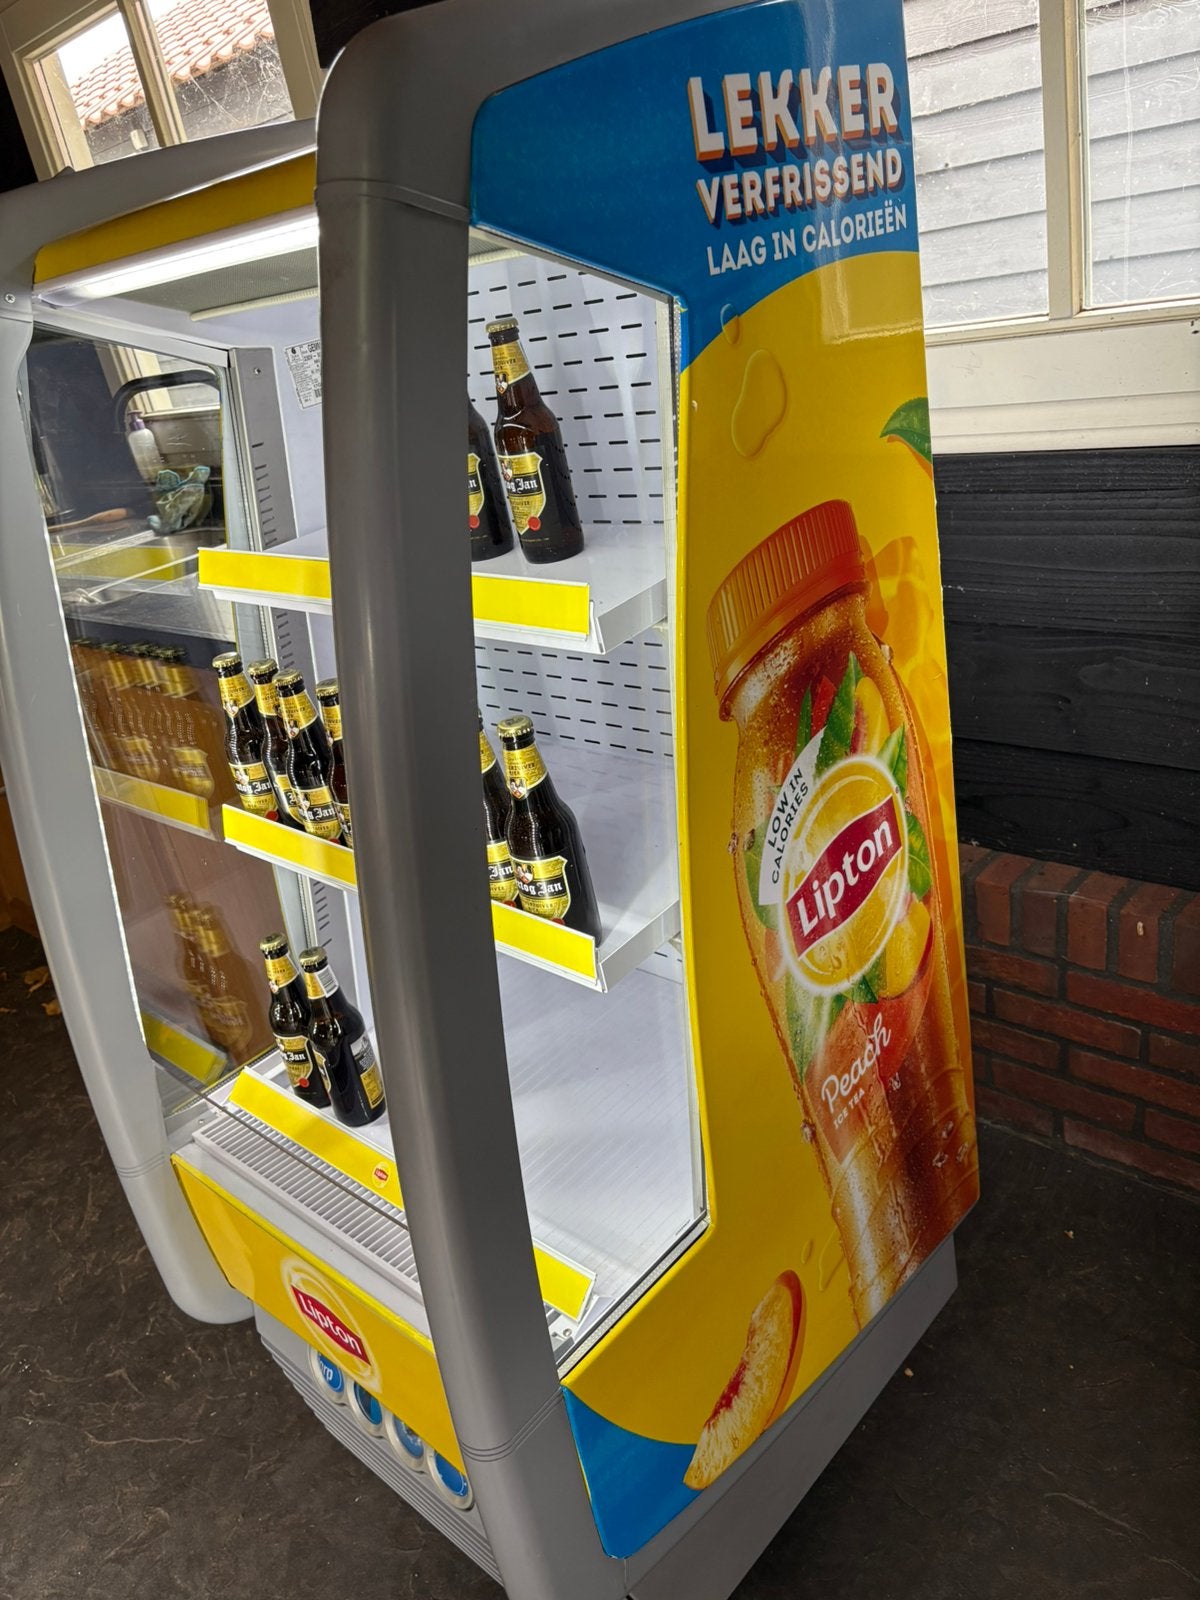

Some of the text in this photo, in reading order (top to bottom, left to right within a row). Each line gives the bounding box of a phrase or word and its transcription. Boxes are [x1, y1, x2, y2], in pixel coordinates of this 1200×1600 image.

[687, 62, 898, 161] LEKKER
[696, 148, 902, 223] VERFRISSEND
[706, 200, 907, 276] LAAG IN CALORIEËN
[516, 478, 538, 494] Jan
[768, 768, 804, 849] LOW IN
[771, 782, 809, 884] CALORIES
[488, 865, 513, 880] Jan
[536, 881, 563, 897] Jan
[796, 820, 893, 937] Lipton
[821, 1012, 891, 1114] Peach
[833, 1088, 865, 1130] ICE TEA
[297, 1292, 362, 1356] Lipton
